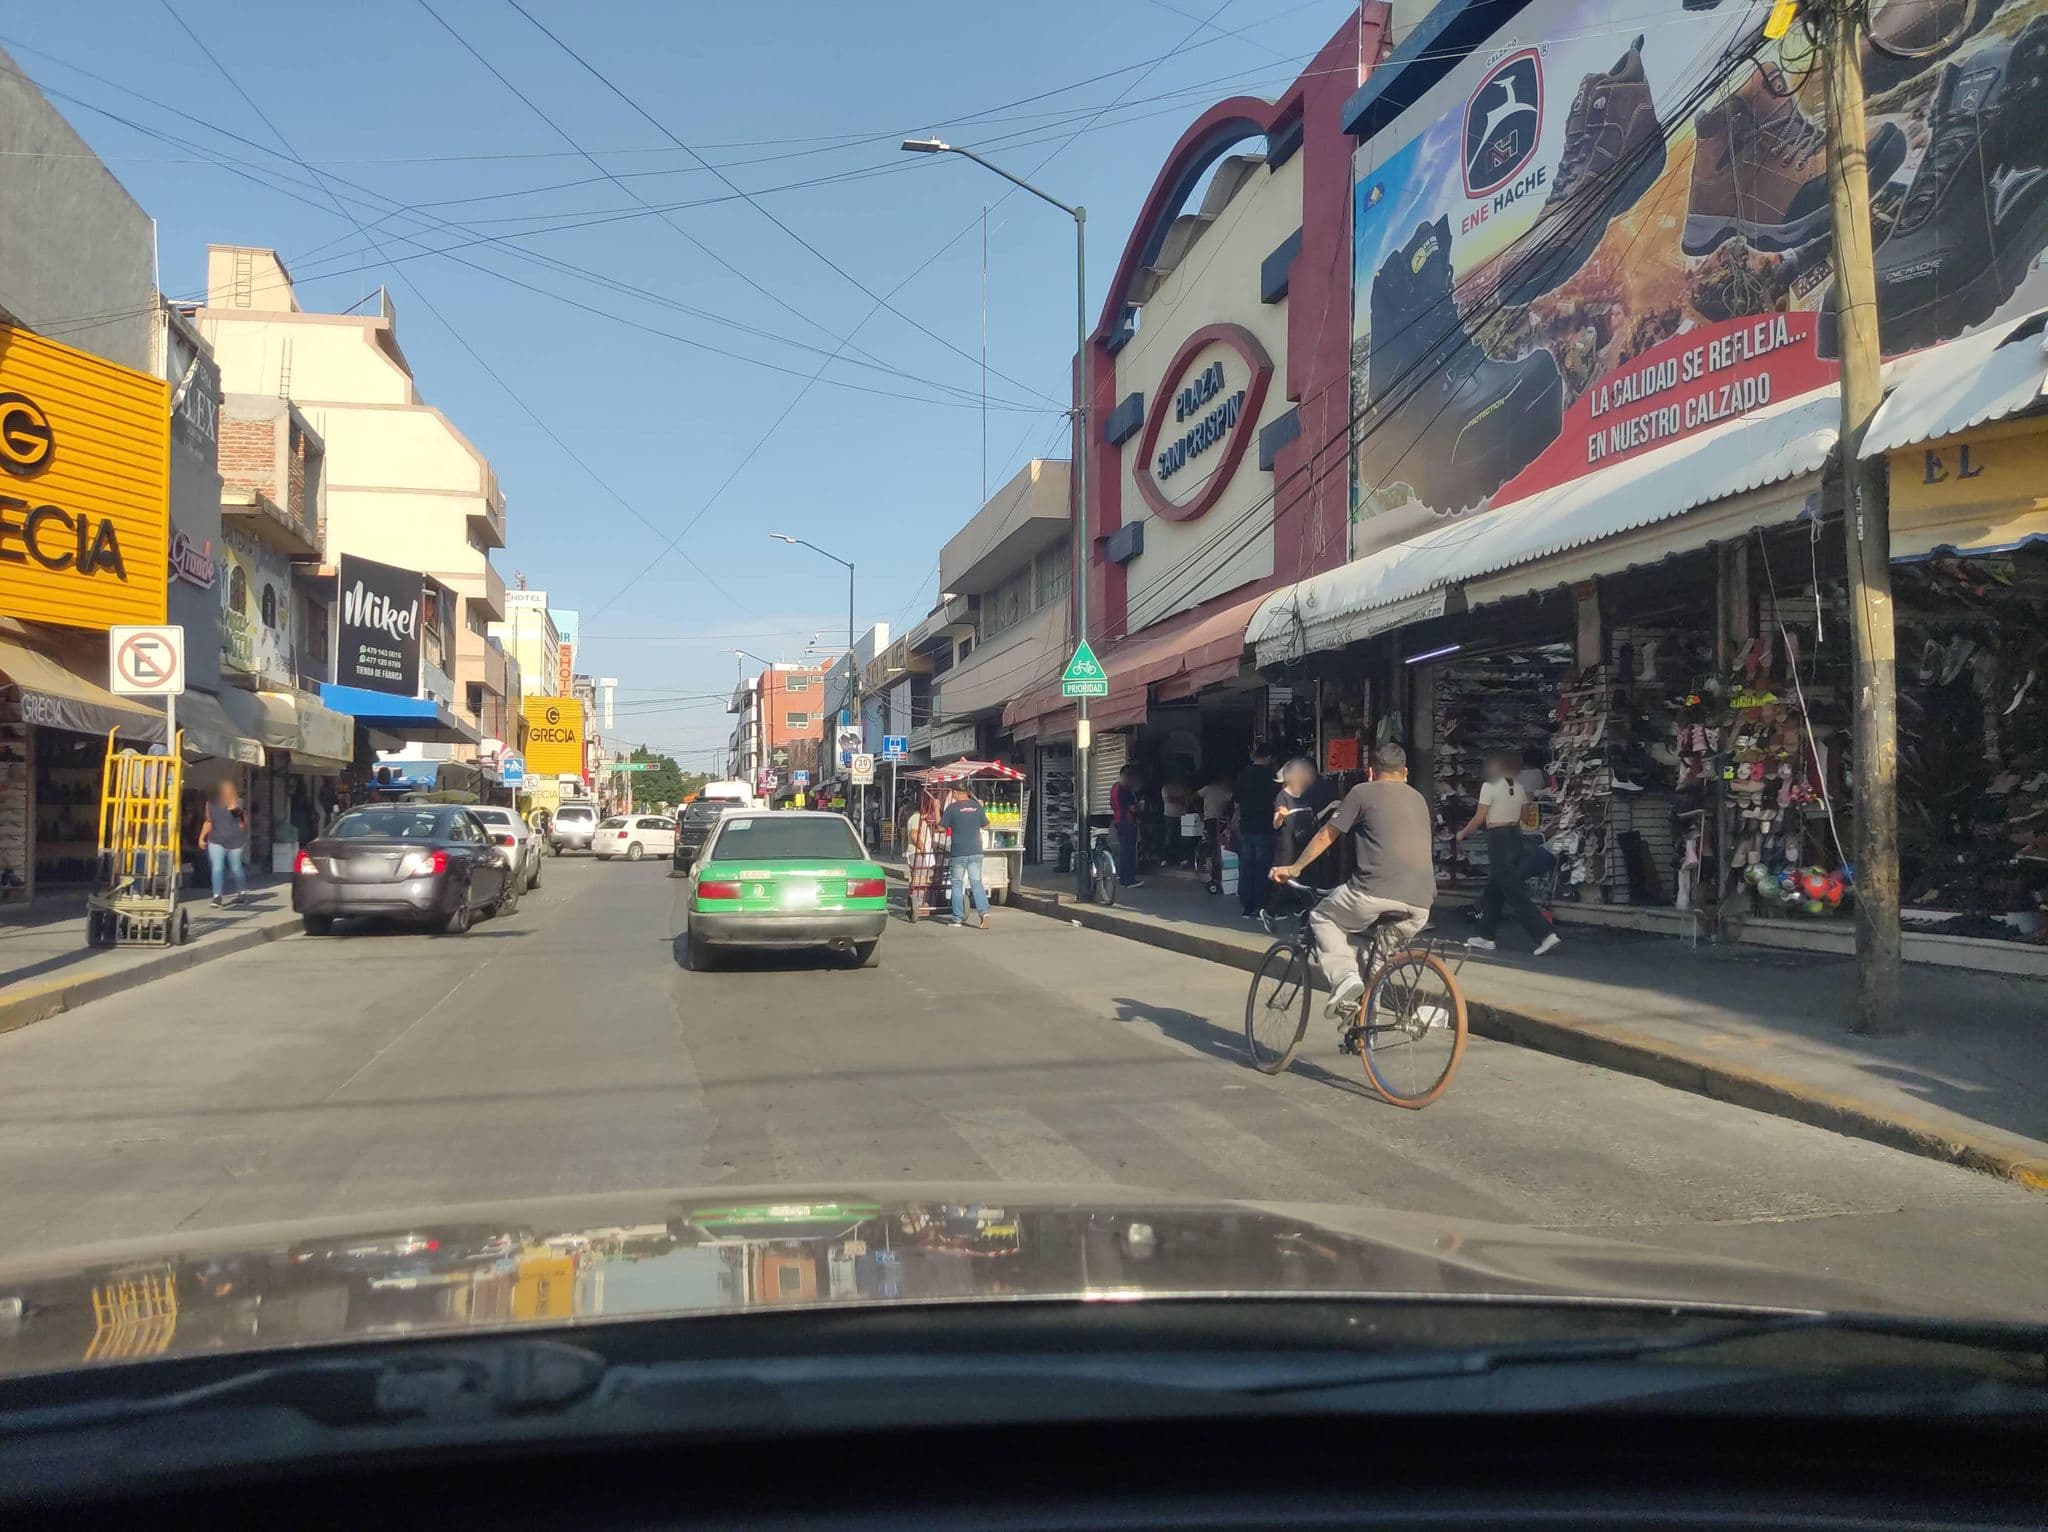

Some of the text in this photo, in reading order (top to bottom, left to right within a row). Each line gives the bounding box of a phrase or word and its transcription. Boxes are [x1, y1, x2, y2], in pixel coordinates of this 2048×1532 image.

[1461, 166, 1546, 235] ENE HACHE
[1591, 315, 1808, 418] LA CALIDAD SE REFLEJA...
[1176, 362, 1225, 422] PLAZA
[1158, 391, 1245, 480] SAN CRISPIN
[1588, 372, 1771, 463] EN NUESTRO CALZADO
[1922, 444, 1985, 484] EL
[344, 580, 418, 641] Mikel
[510, 594, 541, 602] HOTEL
[22, 693, 64, 724] GRECIA
[1067, 684, 1103, 693] PRIORIDAD
[530, 728, 576, 743] GRECIA
[857, 759, 868, 767] 30
